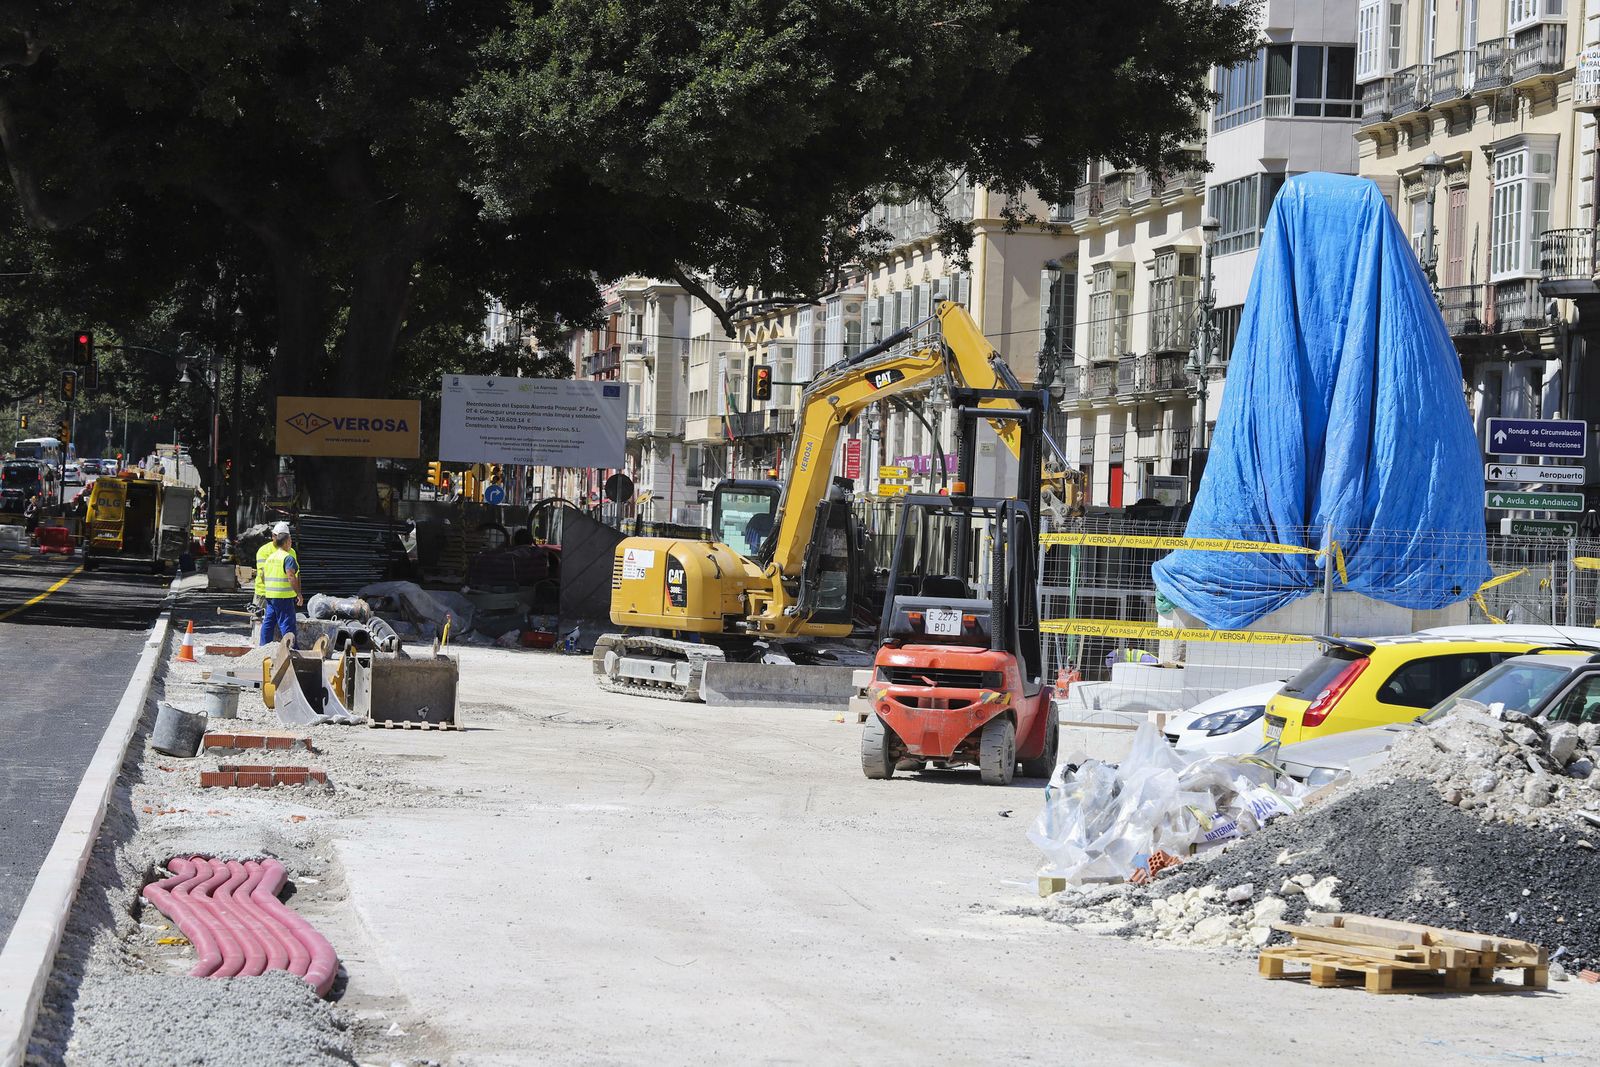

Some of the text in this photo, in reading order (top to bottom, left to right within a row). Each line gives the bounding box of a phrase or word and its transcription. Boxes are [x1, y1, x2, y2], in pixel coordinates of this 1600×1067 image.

[876, 370, 891, 388] CAT
[332, 417, 409, 432] VEROSA
[800, 442, 814, 472] VEROSA
[1539, 471, 1583, 480] Aeropuerto
[98, 498, 120, 507] DLG
[636, 568, 645, 578] 75
[668, 569, 684, 584] CAT
[929, 612, 958, 621] E 2275
[935, 623, 951, 632] BDJ
